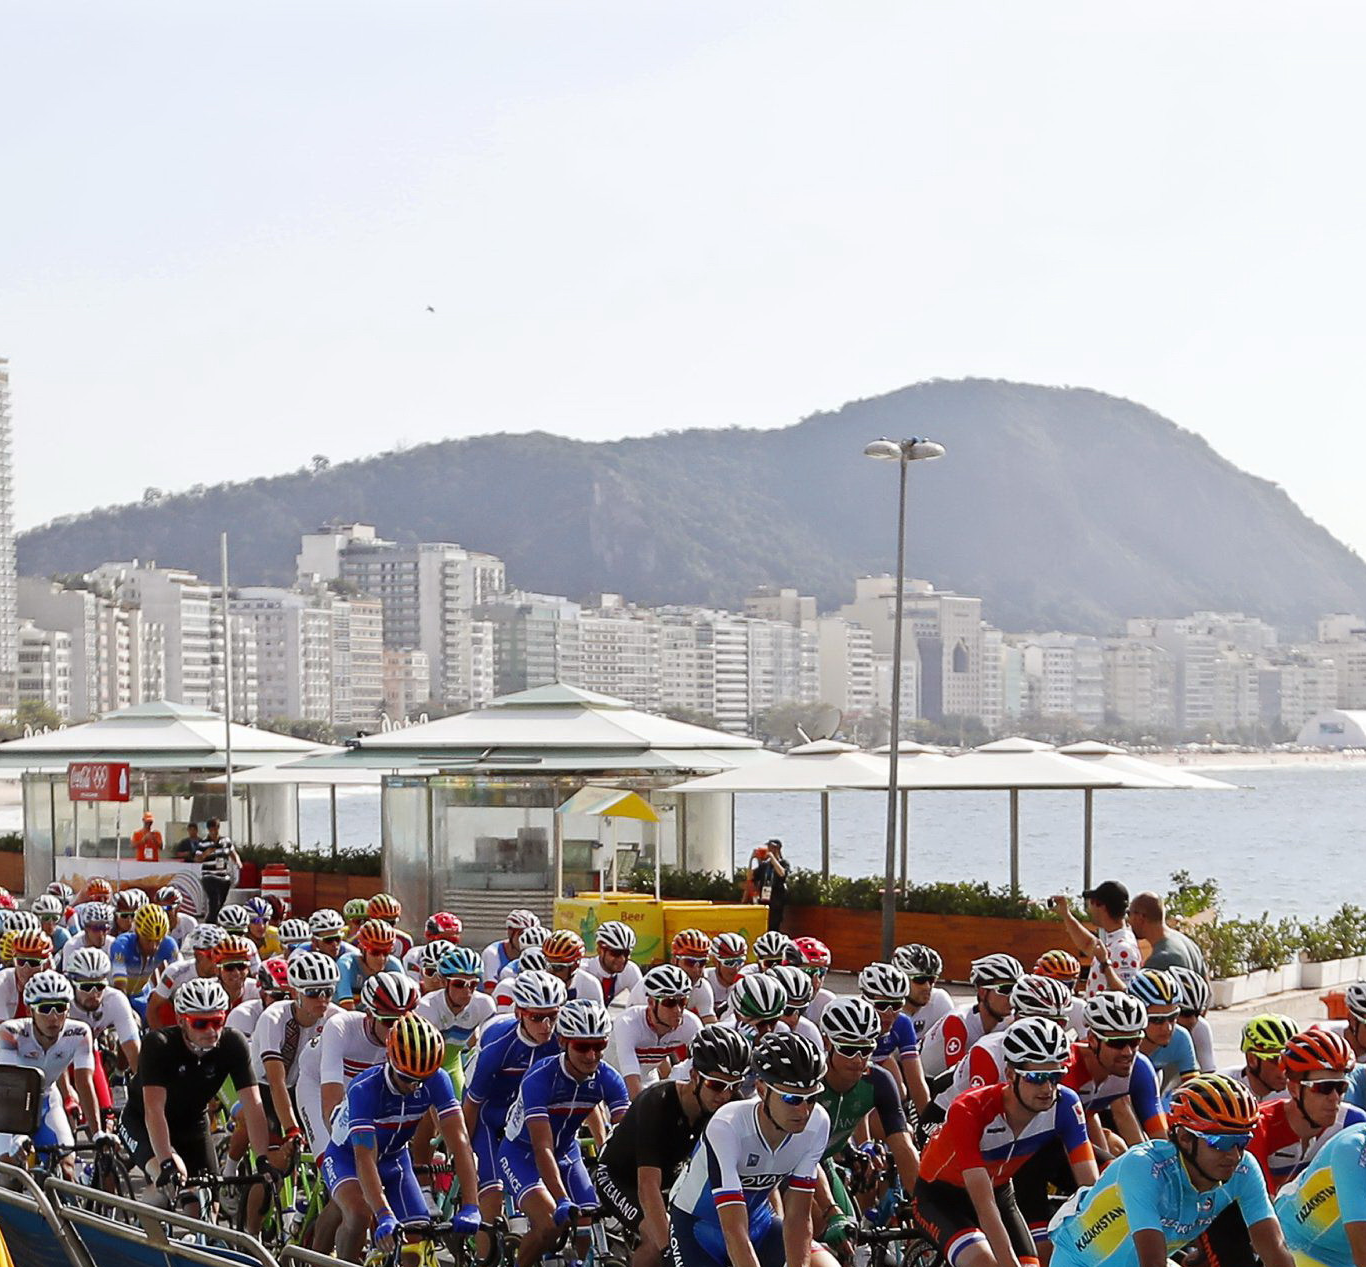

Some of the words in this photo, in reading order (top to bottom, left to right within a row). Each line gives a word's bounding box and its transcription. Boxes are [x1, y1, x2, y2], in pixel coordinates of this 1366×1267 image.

[620, 911, 645, 921] Beer
[301, 1106, 316, 1144] NORGE
[499, 1156, 522, 1194] FRANCE
[603, 1184, 639, 1221] ZEALAND
[1075, 1206, 1126, 1252] KAZAKHSTAN
